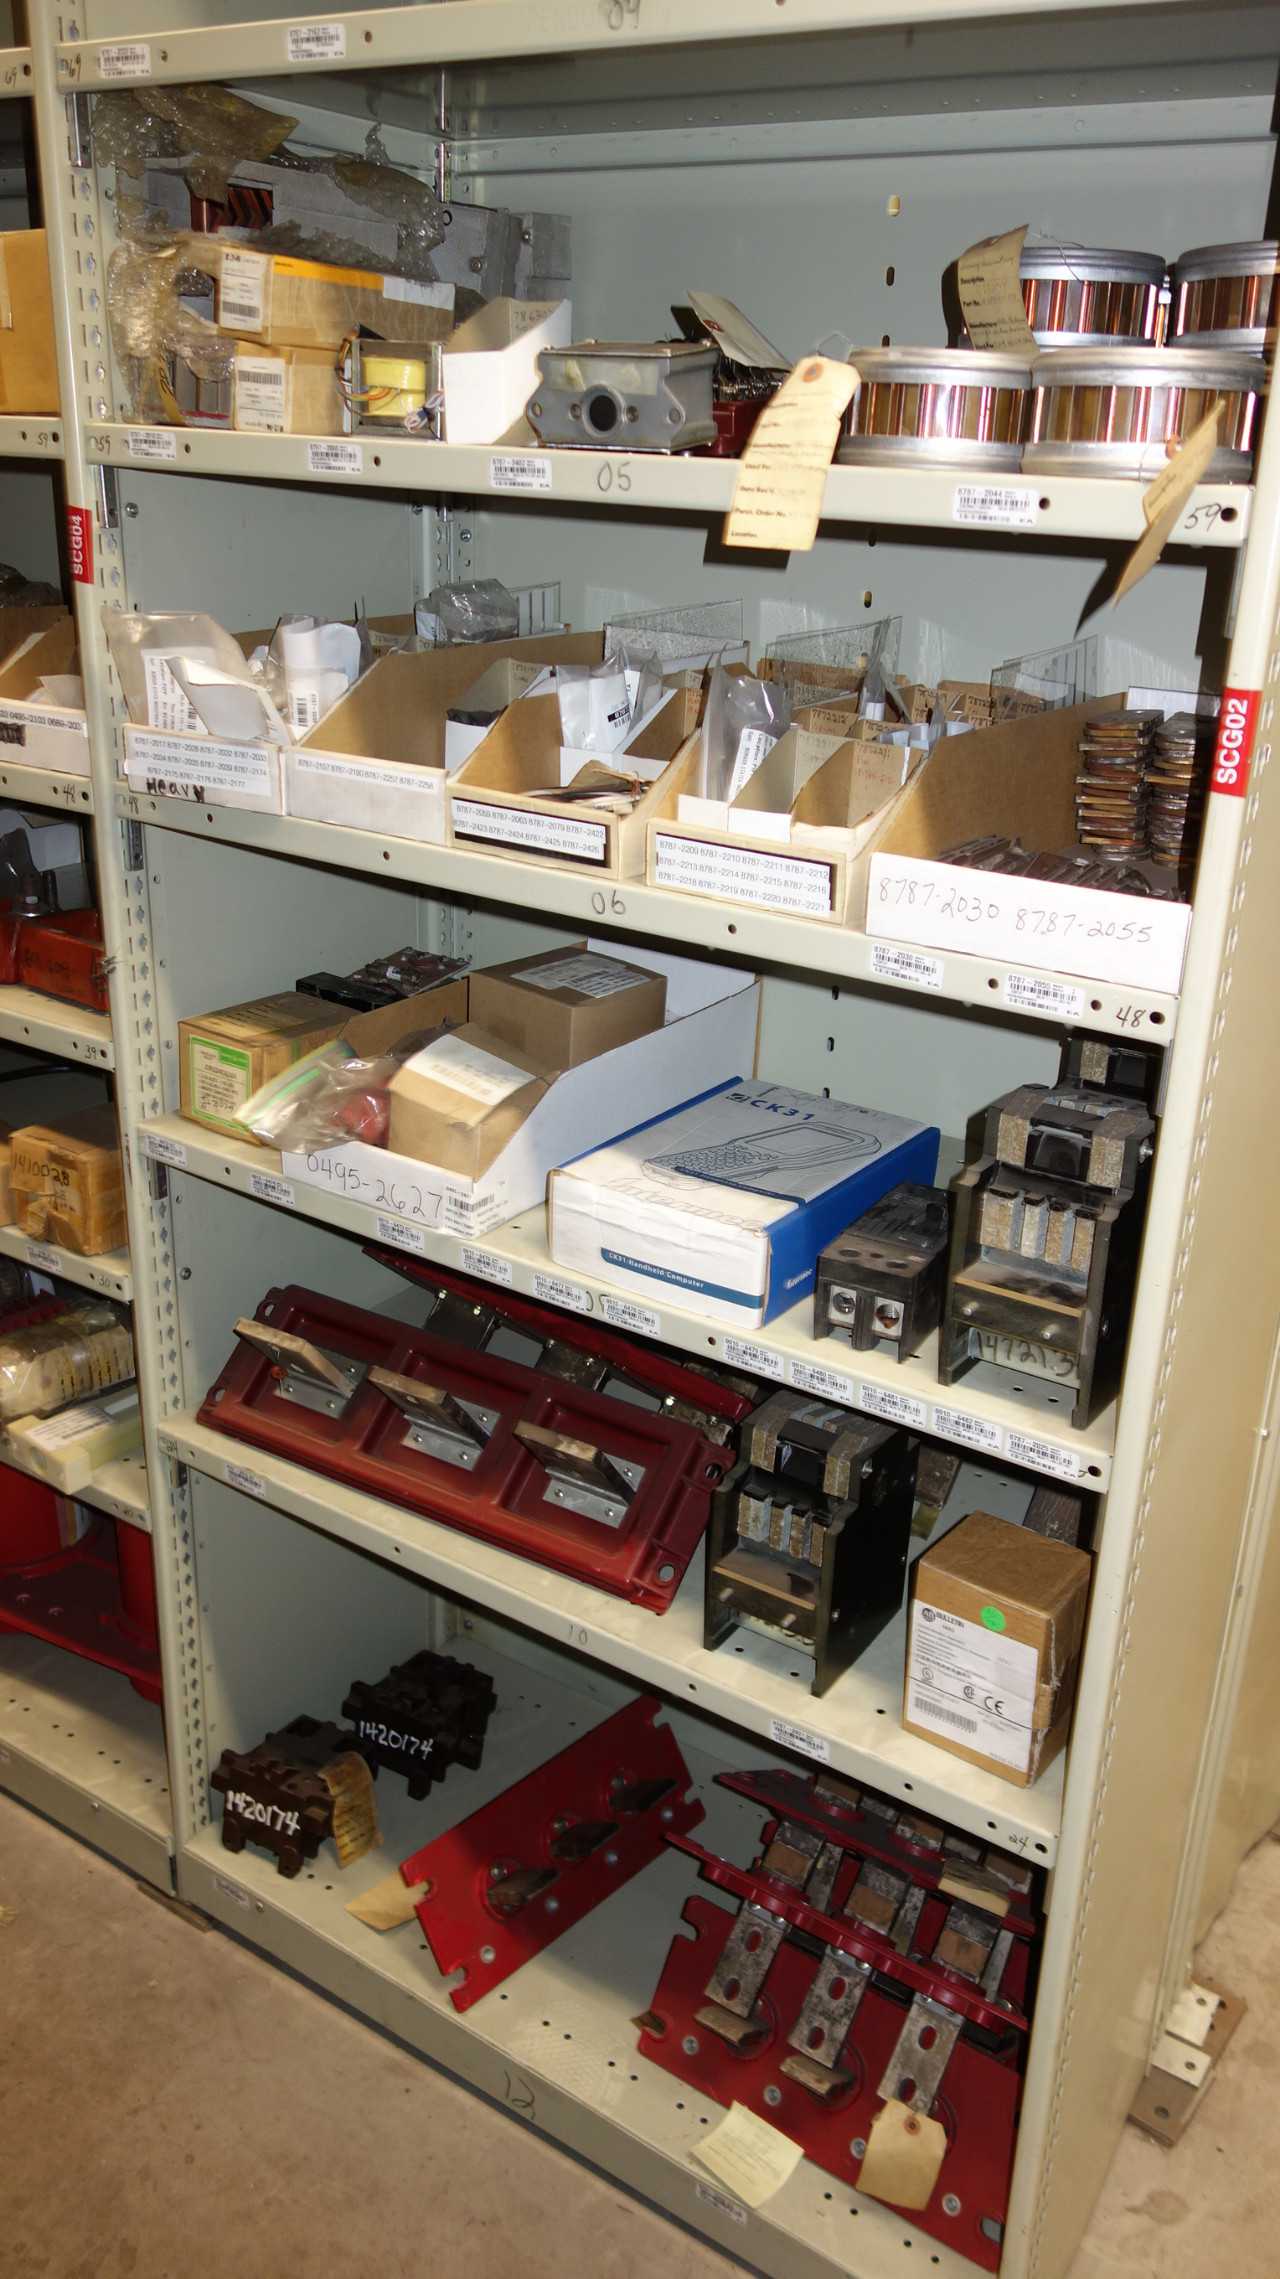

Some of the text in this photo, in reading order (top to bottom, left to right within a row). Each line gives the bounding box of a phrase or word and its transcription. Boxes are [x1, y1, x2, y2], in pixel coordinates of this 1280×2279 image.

[597, 461, 632, 492] 05
[1184, 503, 1221, 532] 59
[70, 515, 83, 576] SCG04
[1216, 698, 1249, 786] SCG02
[591, 891, 627, 915] 06
[879, 877, 1152, 944] 8787-2030 8787-2055
[1116, 1005, 1146, 1028] 48
[751, 1100, 815, 1120] CK31
[306, 1153, 443, 1218] 0495-2627
[359, 1720, 434, 1760] 1420174
[226, 1790, 300, 1836] 1420174
